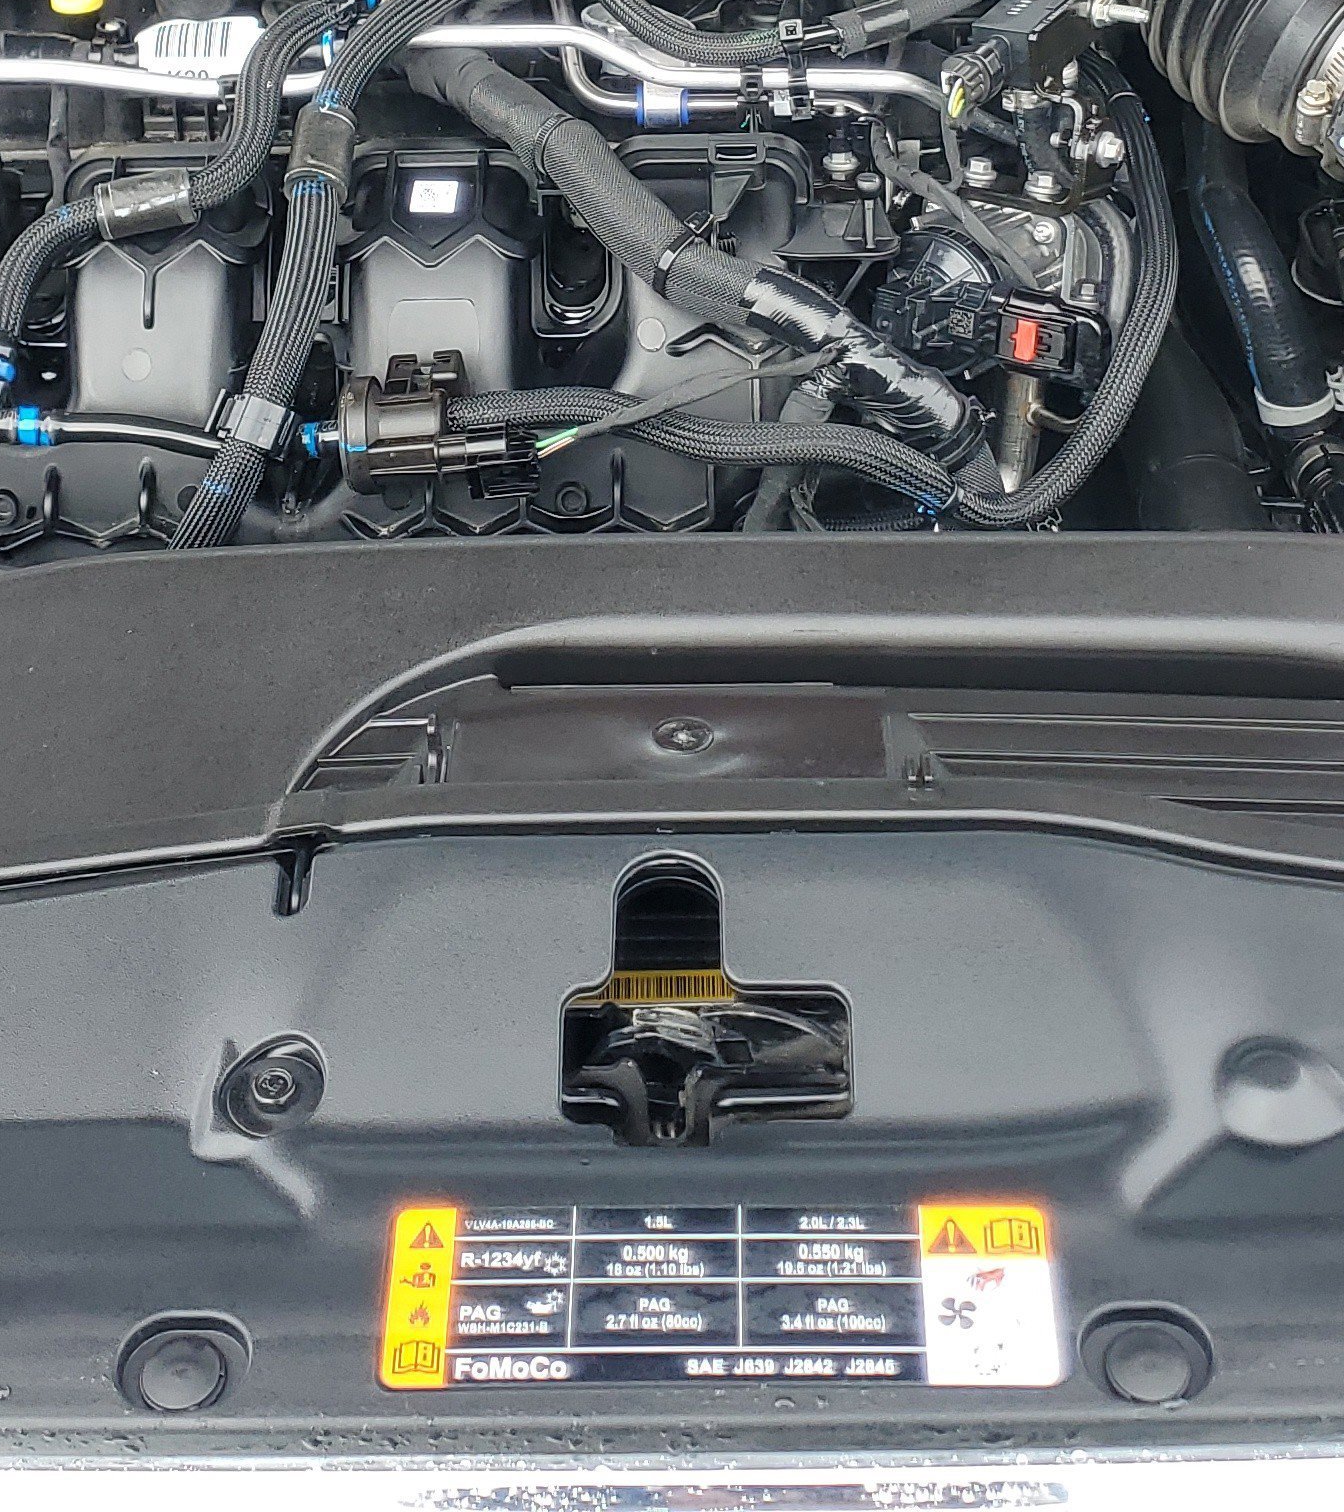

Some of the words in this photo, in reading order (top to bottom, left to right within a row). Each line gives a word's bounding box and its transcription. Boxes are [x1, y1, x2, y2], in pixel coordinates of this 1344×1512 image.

[644, 1215, 673, 1230] 1.5L
[798, 1216, 828, 1230] 2.0L
[460, 1251, 542, 1270] R-1234yf
[622, 1245, 665, 1261] 0.500
[668, 1245, 689, 1264] kg
[798, 1243, 840, 1259] 0.550
[844, 1243, 864, 1263] kg
[625, 1266, 642, 1276] oz
[644, 1262, 677, 1278] (1.10
[679, 1262, 705, 1278] lbs)
[807, 1264, 823, 1275] oz
[862, 1261, 887, 1276] lbs)
[459, 1305, 501, 1321] PAG
[639, 1298, 671, 1312] PAG
[817, 1298, 850, 1312] PAG
[605, 1315, 627, 1330] 2.7
[629, 1315, 639, 1330] fl
[640, 1318, 659, 1330] oz
[782, 1315, 804, 1330] 3.4
[805, 1315, 815, 1330] fl
[817, 1318, 834, 1330] oz
[837, 1314, 886, 1332] (100cc)
[454, 1356, 567, 1380] FoMoCo
[685, 1358, 723, 1375] SAE
